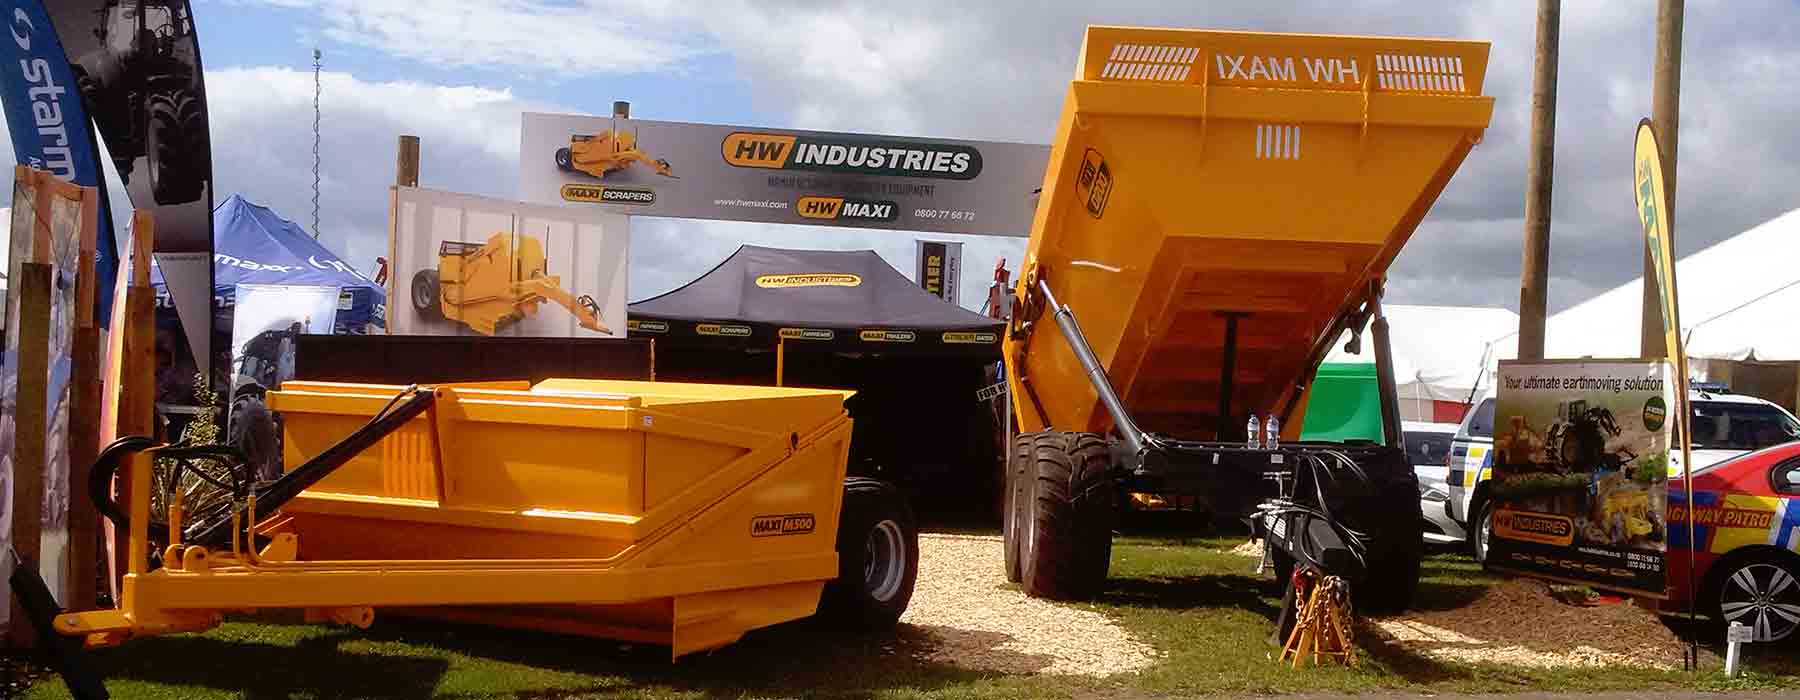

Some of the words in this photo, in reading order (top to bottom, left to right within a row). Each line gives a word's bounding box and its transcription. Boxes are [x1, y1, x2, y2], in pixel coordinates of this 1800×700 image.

[735, 138, 785, 161] HW
[794, 142, 971, 173] INDUSTRIES
[603, 191, 653, 201] SCRAPERS
[714, 199, 788, 209] www.hwmaxi.com
[805, 201, 837, 214] HW
[842, 203, 892, 218] MAXI
[914, 208, 937, 218] 0800
[1505, 375, 1522, 388] Your
[1523, 376, 1560, 390] ultimate
[1563, 376, 1620, 392] earthmoving
[1624, 375, 1663, 391] solution
[754, 520, 780, 534] MAXI
[783, 518, 812, 530] M500
